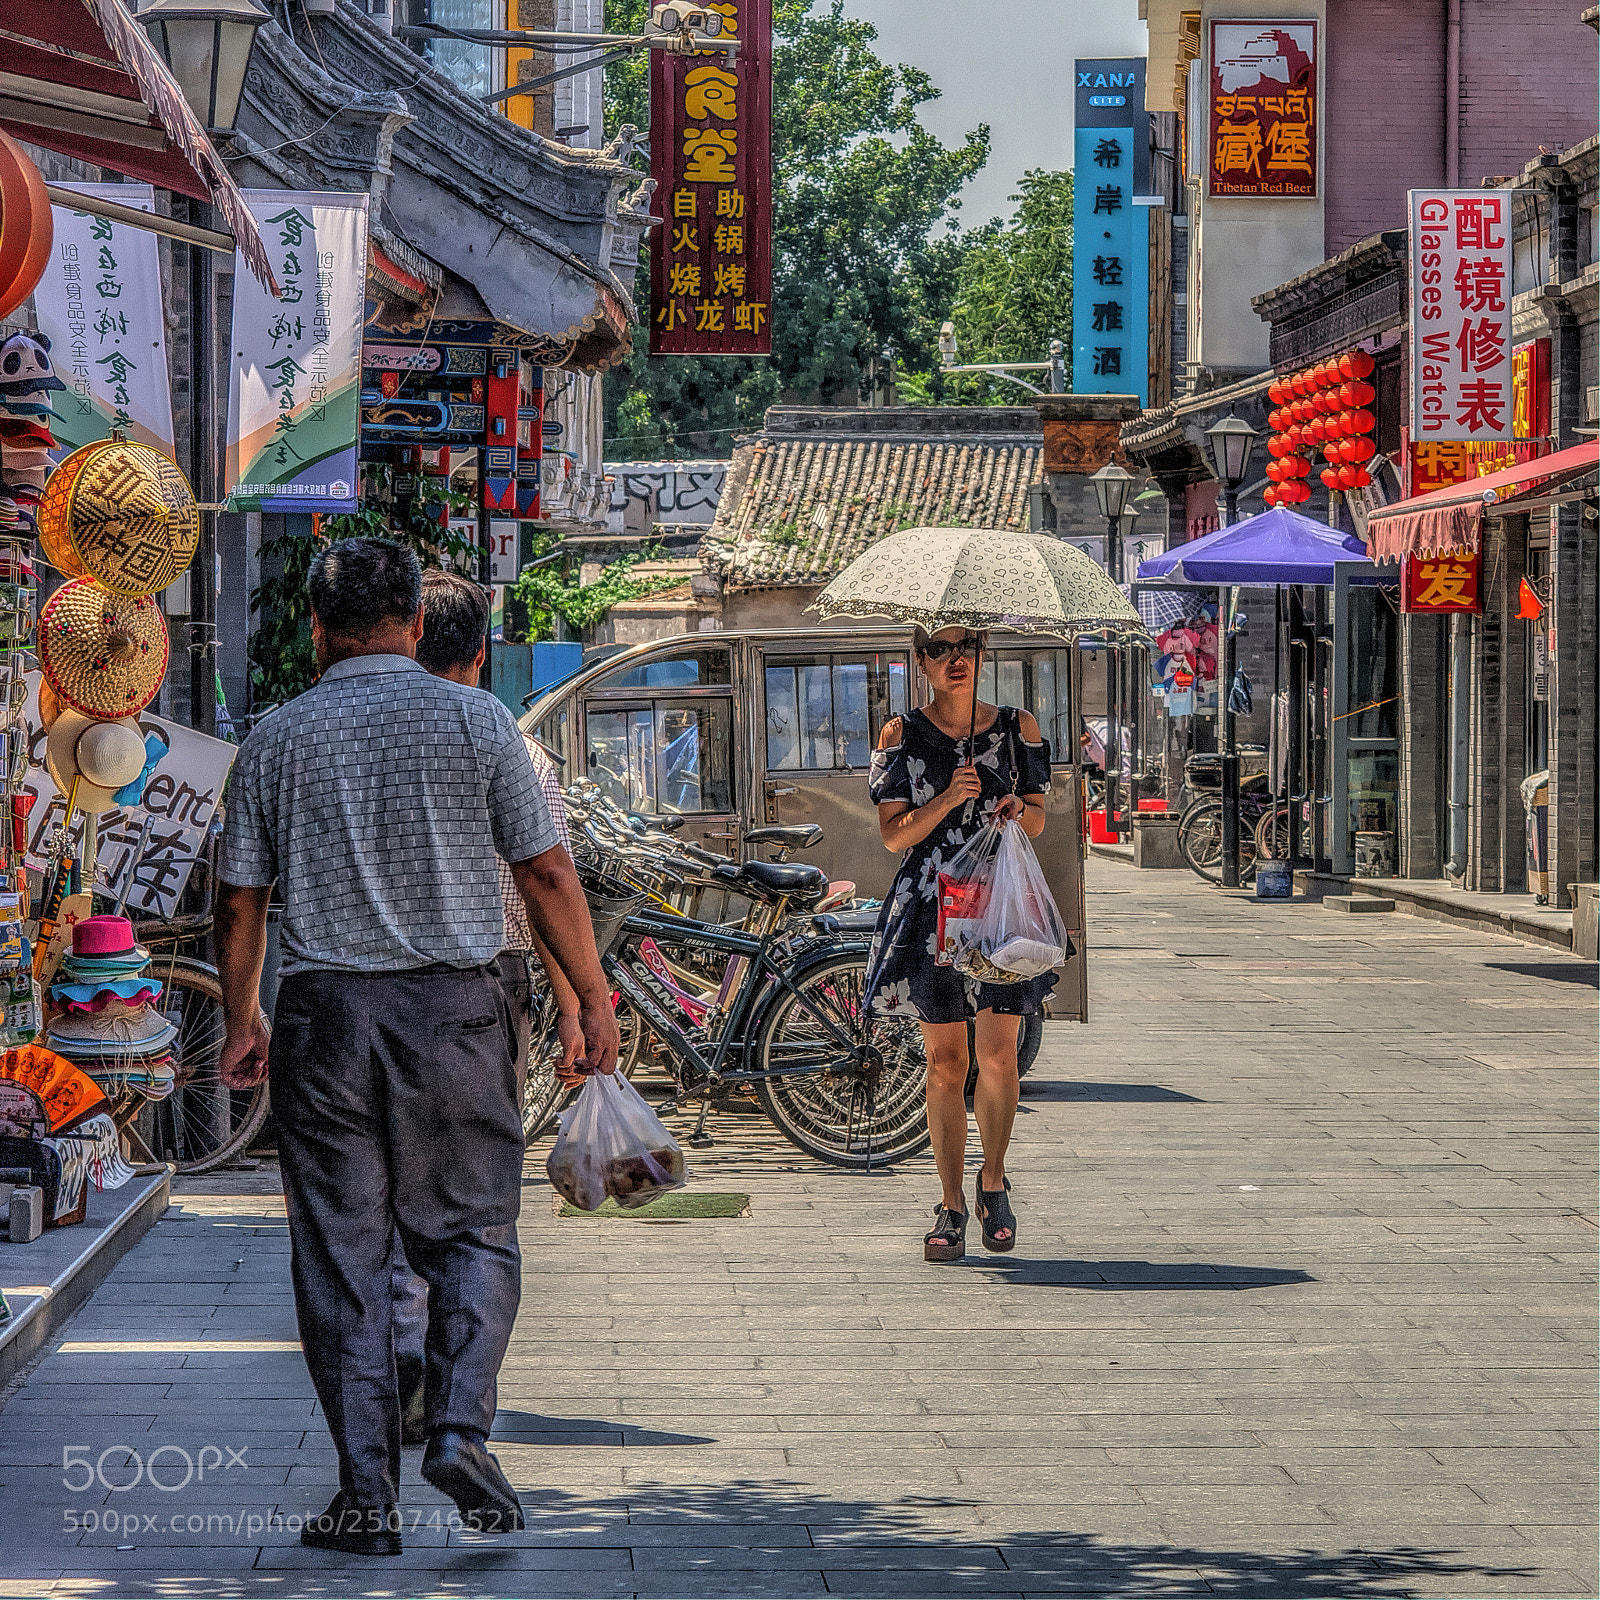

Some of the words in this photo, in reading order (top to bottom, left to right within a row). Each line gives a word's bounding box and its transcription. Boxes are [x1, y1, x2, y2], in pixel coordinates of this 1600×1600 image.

[1077, 72, 1135, 88] XANA
[1093, 96, 1122, 105] LITE
[1214, 118, 1313, 178] 藏堡
[673, 188, 745, 219] 自助
[1213, 182, 1258, 193] Tibetan
[1260, 182, 1283, 193] Red
[1285, 182, 1312, 193] Beer
[671, 222, 744, 255] 火锅
[1092, 137, 1123, 392] 希岸·轻雅酒
[1420, 198, 1449, 321] Glasses
[669, 262, 746, 298] 烧烤
[656, 299, 768, 335] 小龙虾
[1453, 197, 1506, 434] 配镜修表
[1422, 331, 1451, 431] Watch
[142, 774, 214, 828] ent
[24, 786, 192, 907] 自行车
[631, 961, 685, 1016] GIANT
